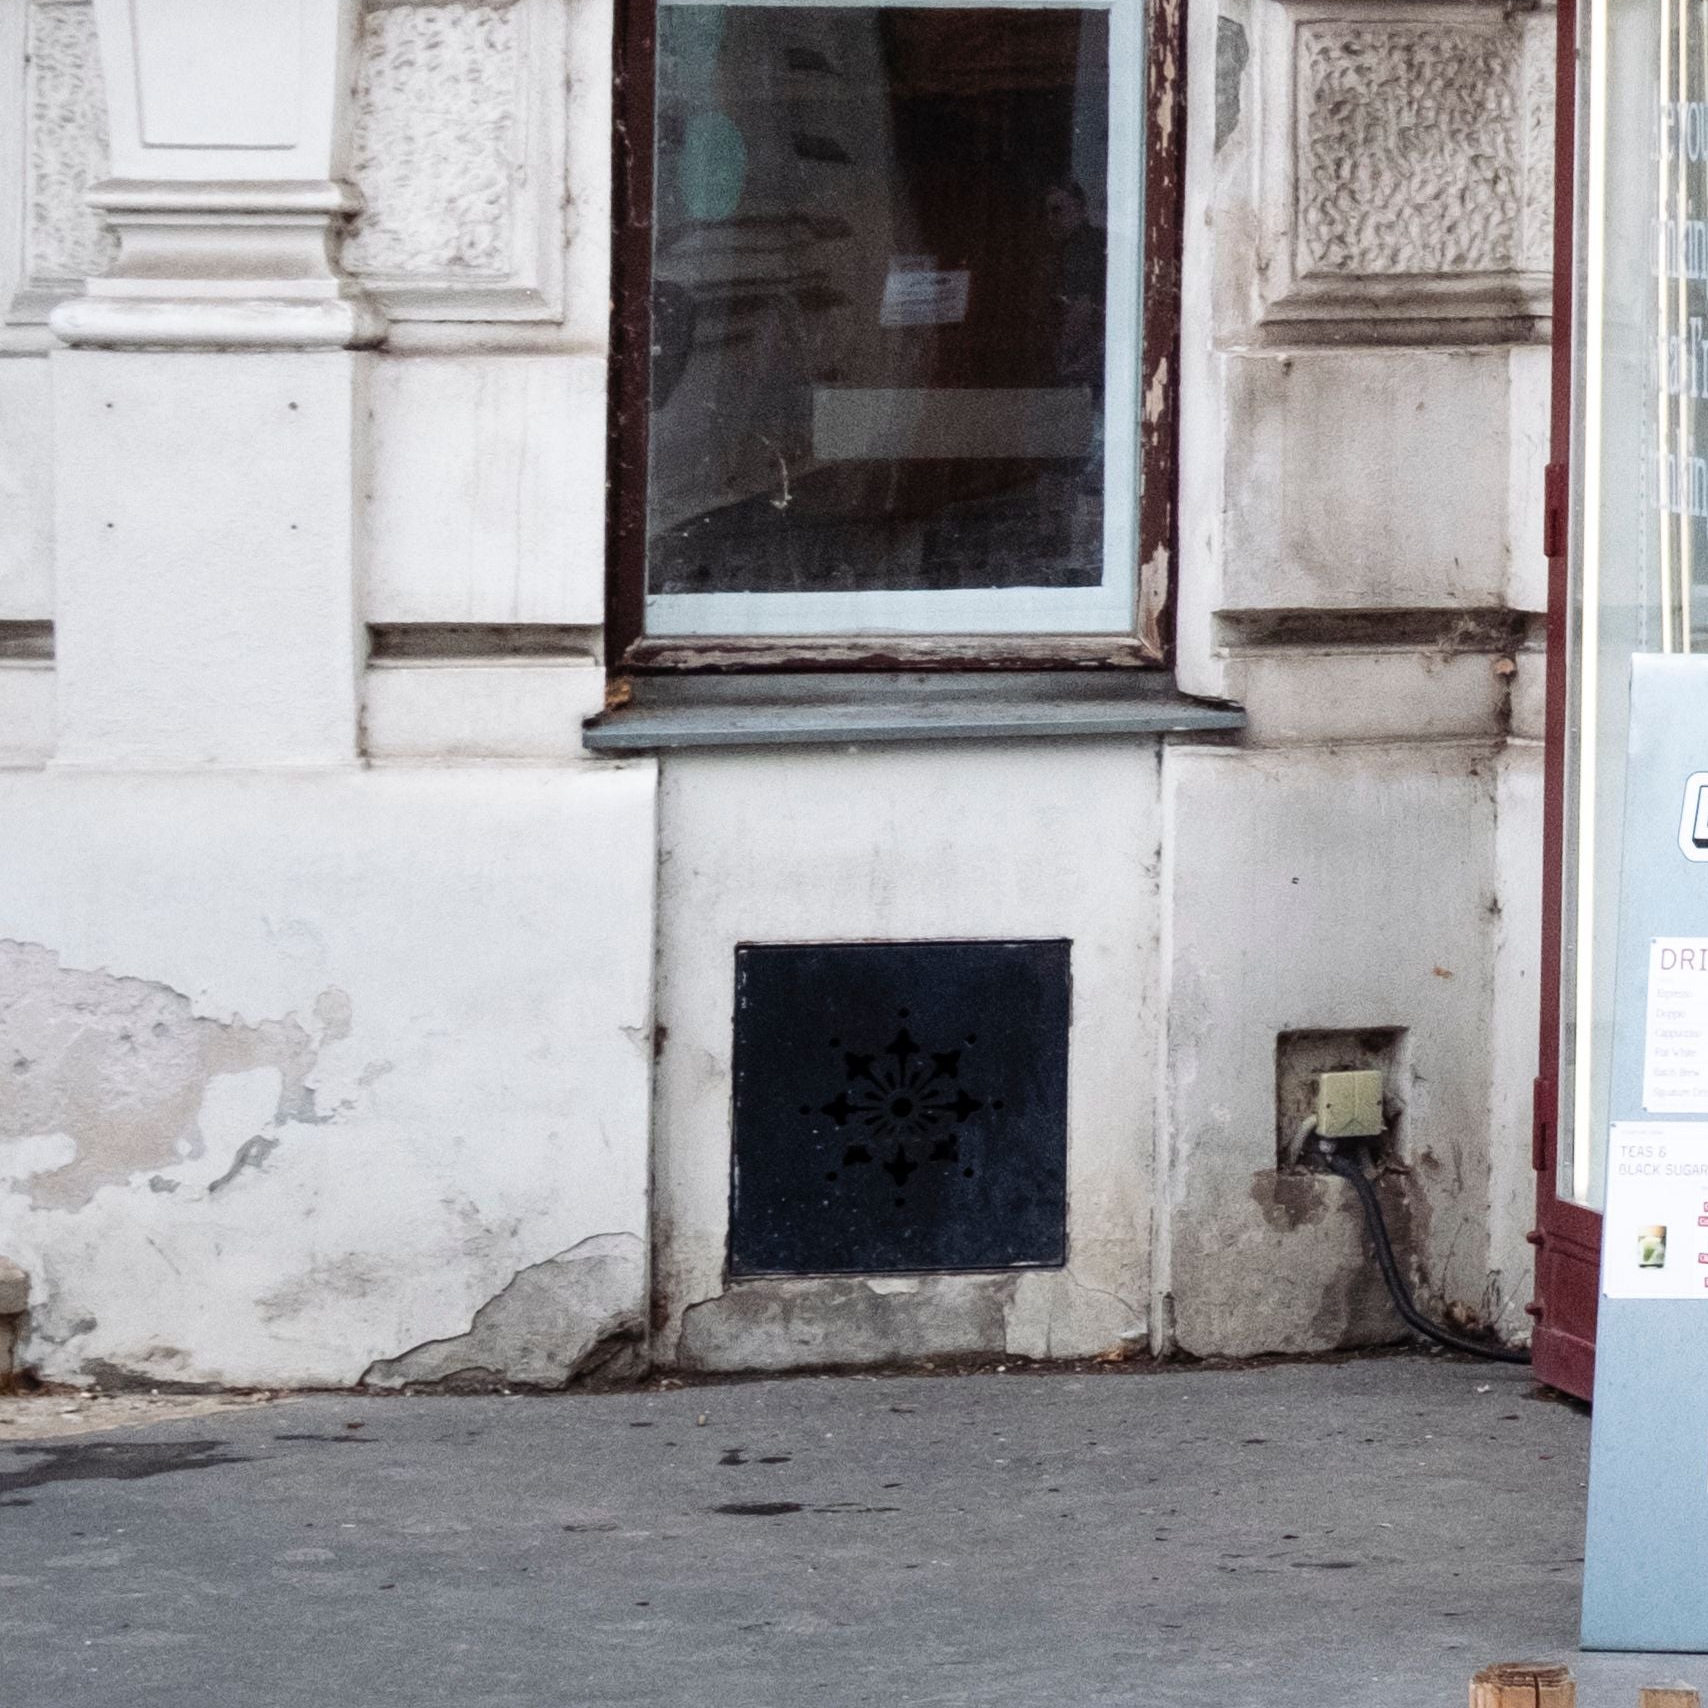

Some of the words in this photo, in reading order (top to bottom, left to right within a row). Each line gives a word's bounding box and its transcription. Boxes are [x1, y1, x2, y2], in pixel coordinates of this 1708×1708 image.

[1620, 1145, 1654, 1158] TEAS
[1619, 1163, 1661, 1176] BLACK
[1665, 1163, 1708, 1176] SUGAR
